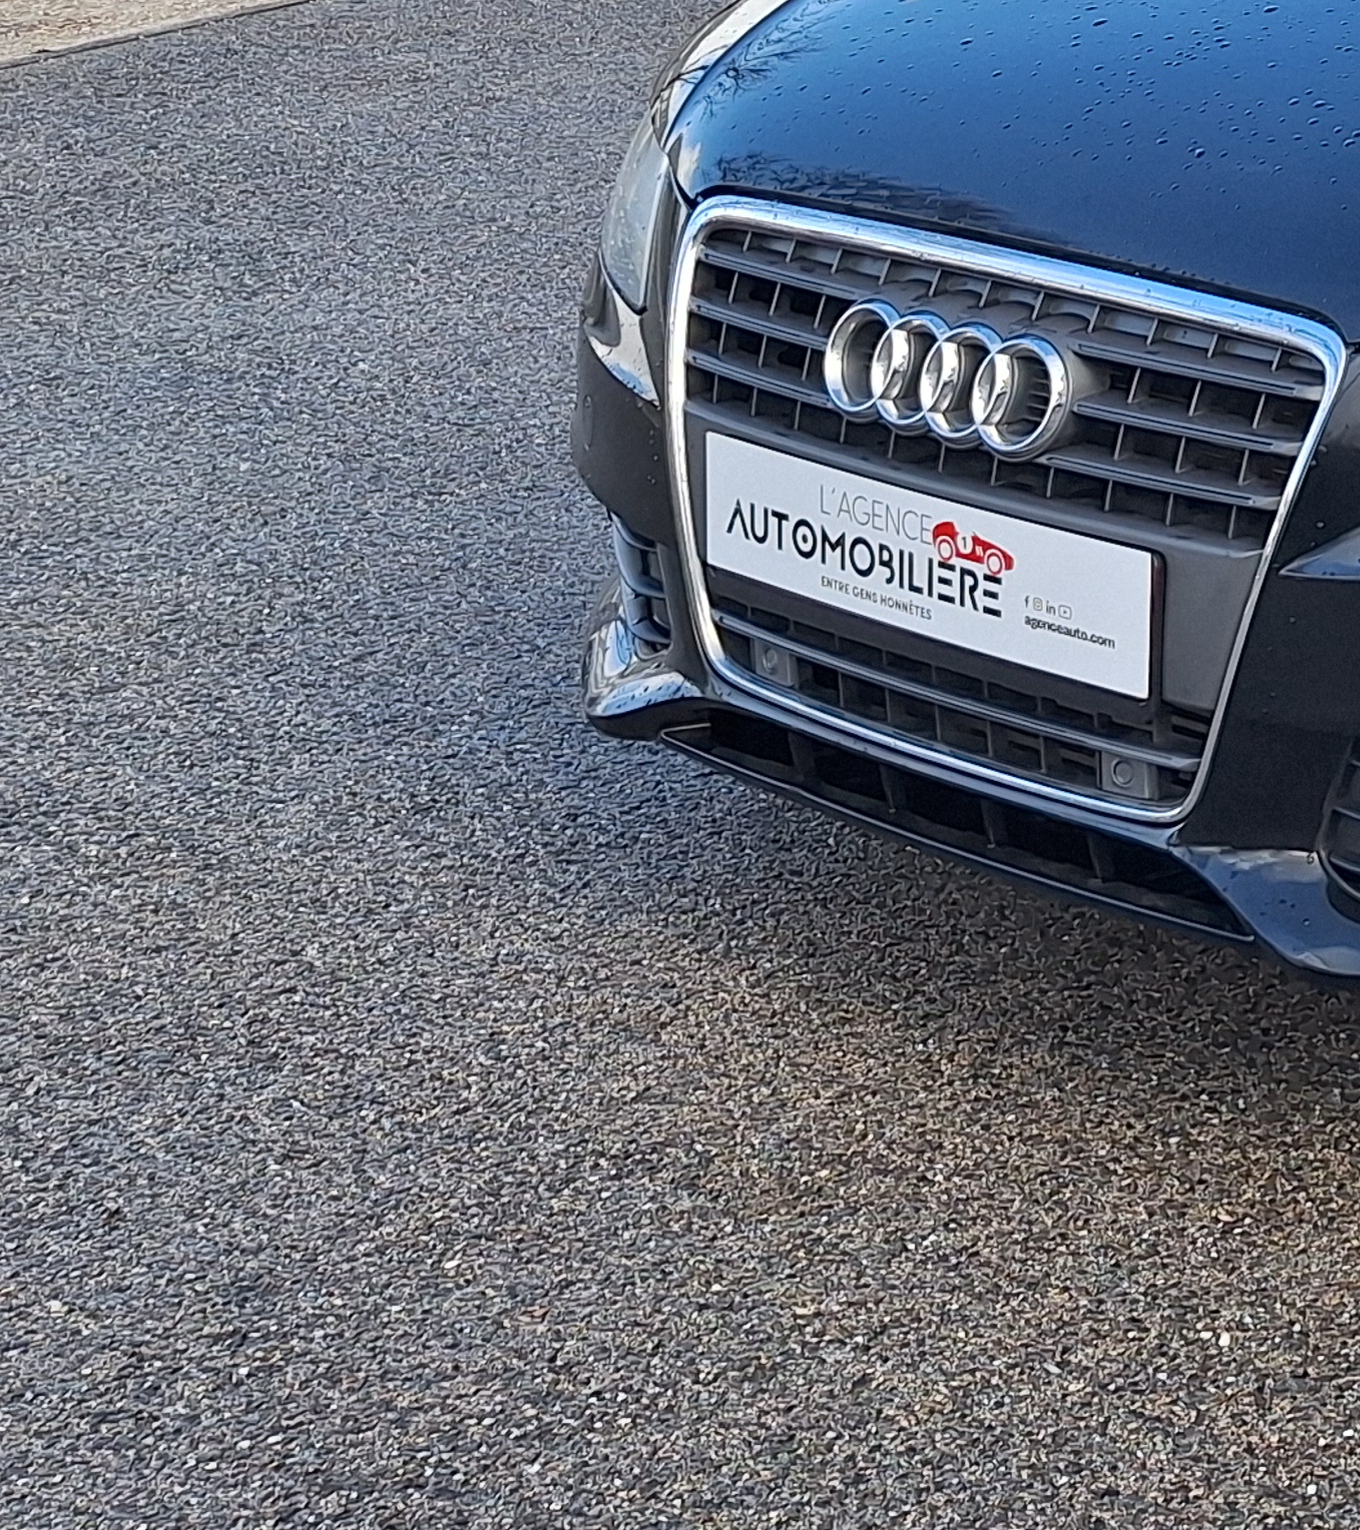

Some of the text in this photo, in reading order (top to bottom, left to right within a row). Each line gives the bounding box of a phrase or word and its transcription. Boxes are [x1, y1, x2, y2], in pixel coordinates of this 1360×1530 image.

[819, 483, 933, 546] L'AGENCE
[821, 575, 933, 621] ENTRE GENS HONNÊTES
[1024, 614, 1116, 650] agenceauto.com
